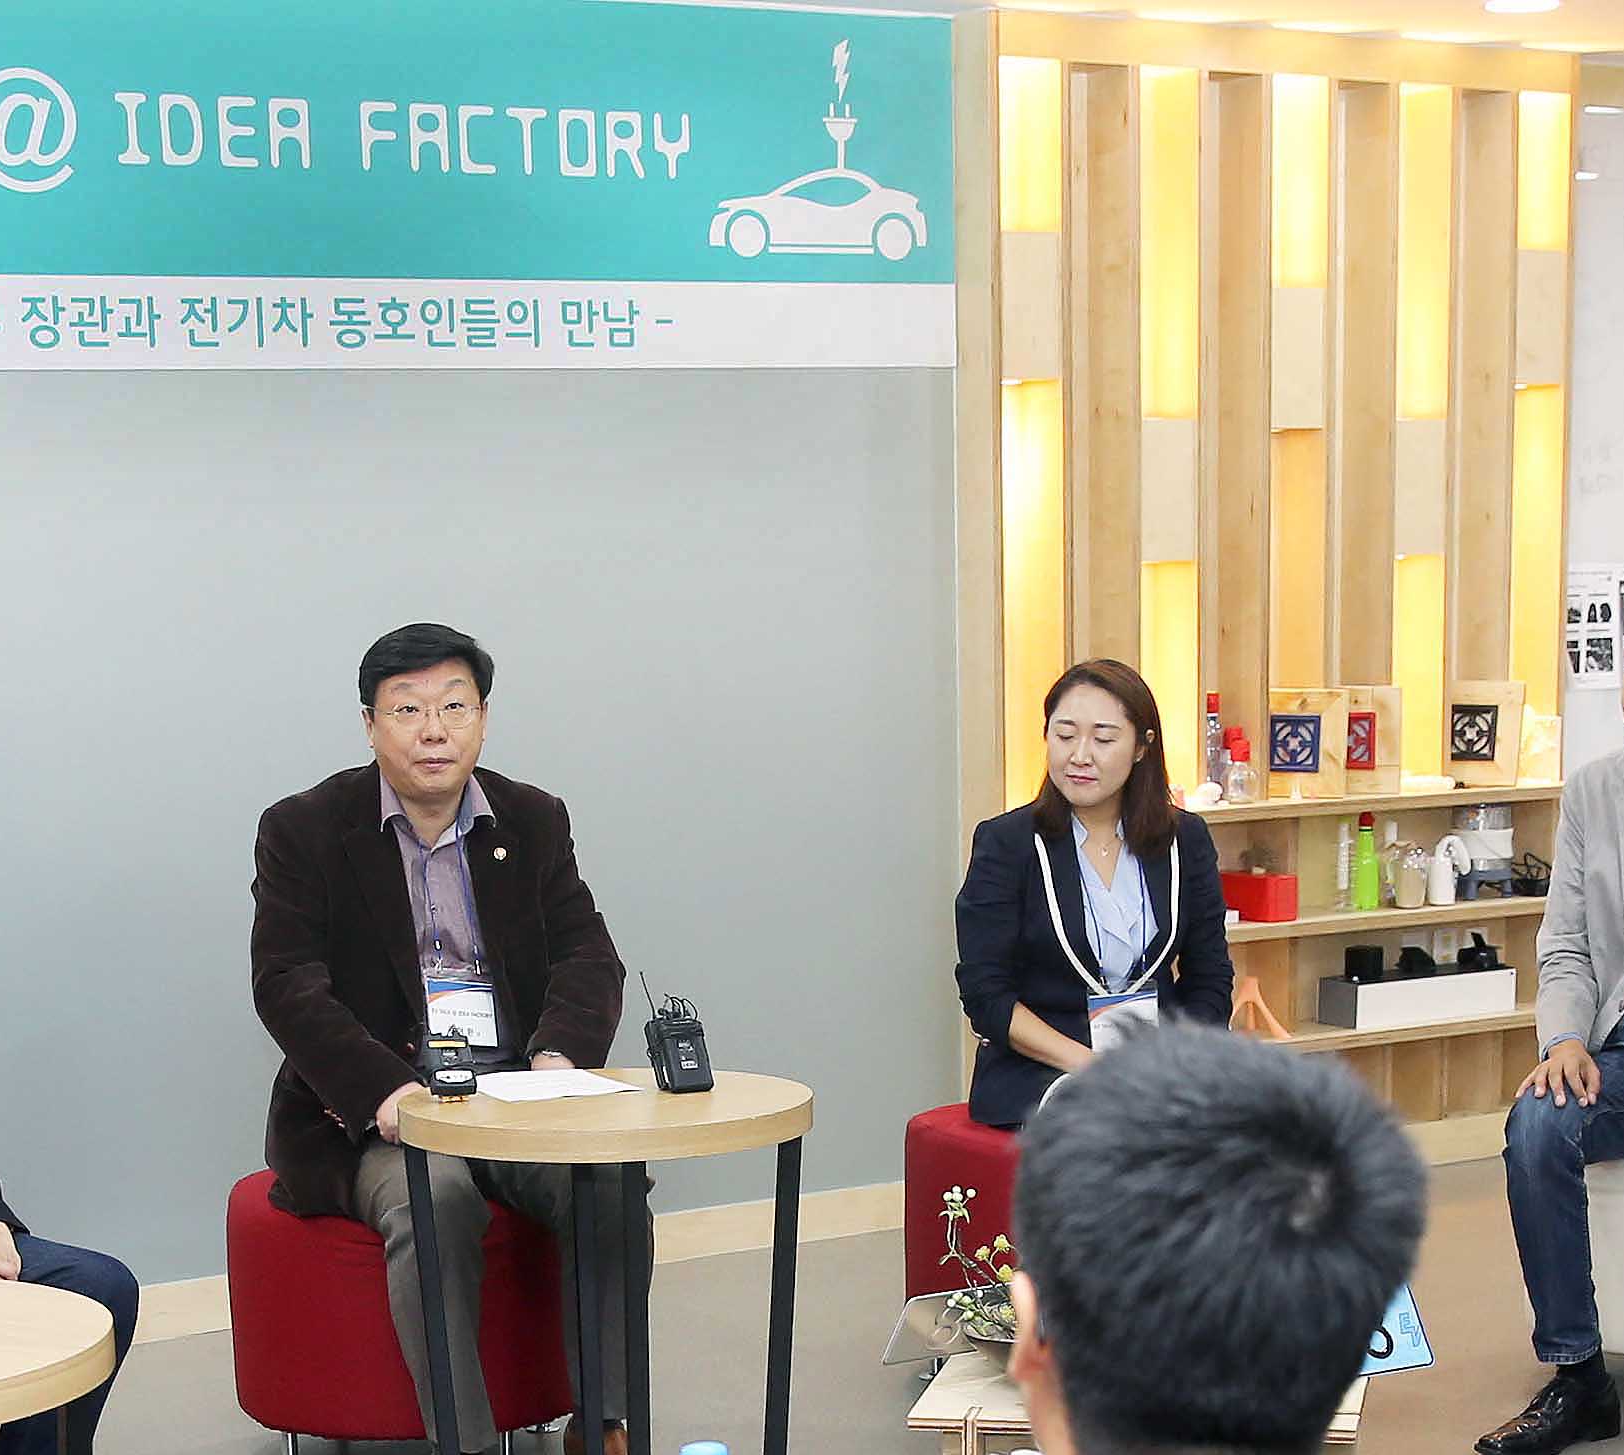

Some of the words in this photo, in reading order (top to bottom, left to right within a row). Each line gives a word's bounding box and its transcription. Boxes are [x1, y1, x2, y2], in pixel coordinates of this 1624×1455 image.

[115, 92, 312, 169] IDEA
[359, 100, 692, 179] FACTORY
[21, 294, 163, 351] 장관과
[180, 296, 314, 350] 전기차
[328, 296, 543, 351] 동호인들의
[561, 300, 642, 349] 만남
